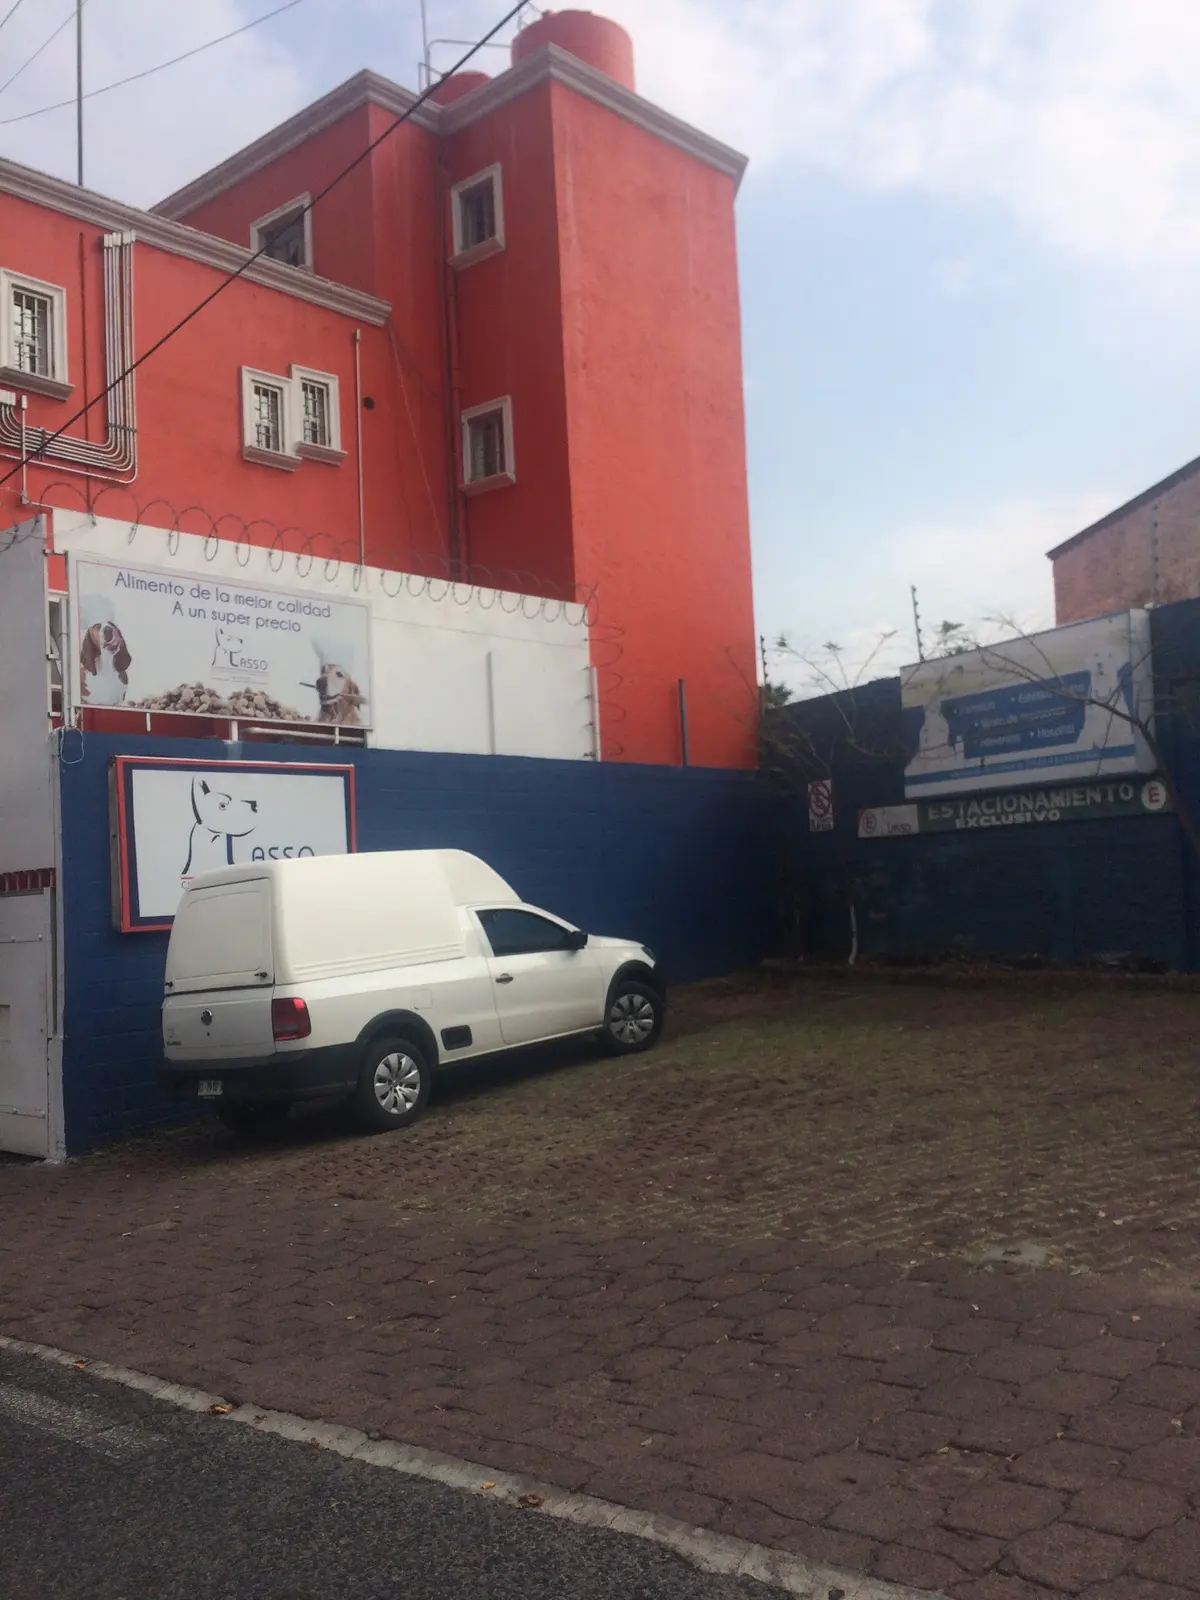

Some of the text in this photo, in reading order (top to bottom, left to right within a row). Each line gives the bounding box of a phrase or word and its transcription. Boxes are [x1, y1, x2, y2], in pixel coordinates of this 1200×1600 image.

[114, 571, 331, 618] Alimento de la mejor calidad
[172, 601, 301, 633] A un super precio
[928, 783, 1161, 820] ESTACIONAMIENTO E
[955, 809, 1060, 828] EXCLUSIVO
